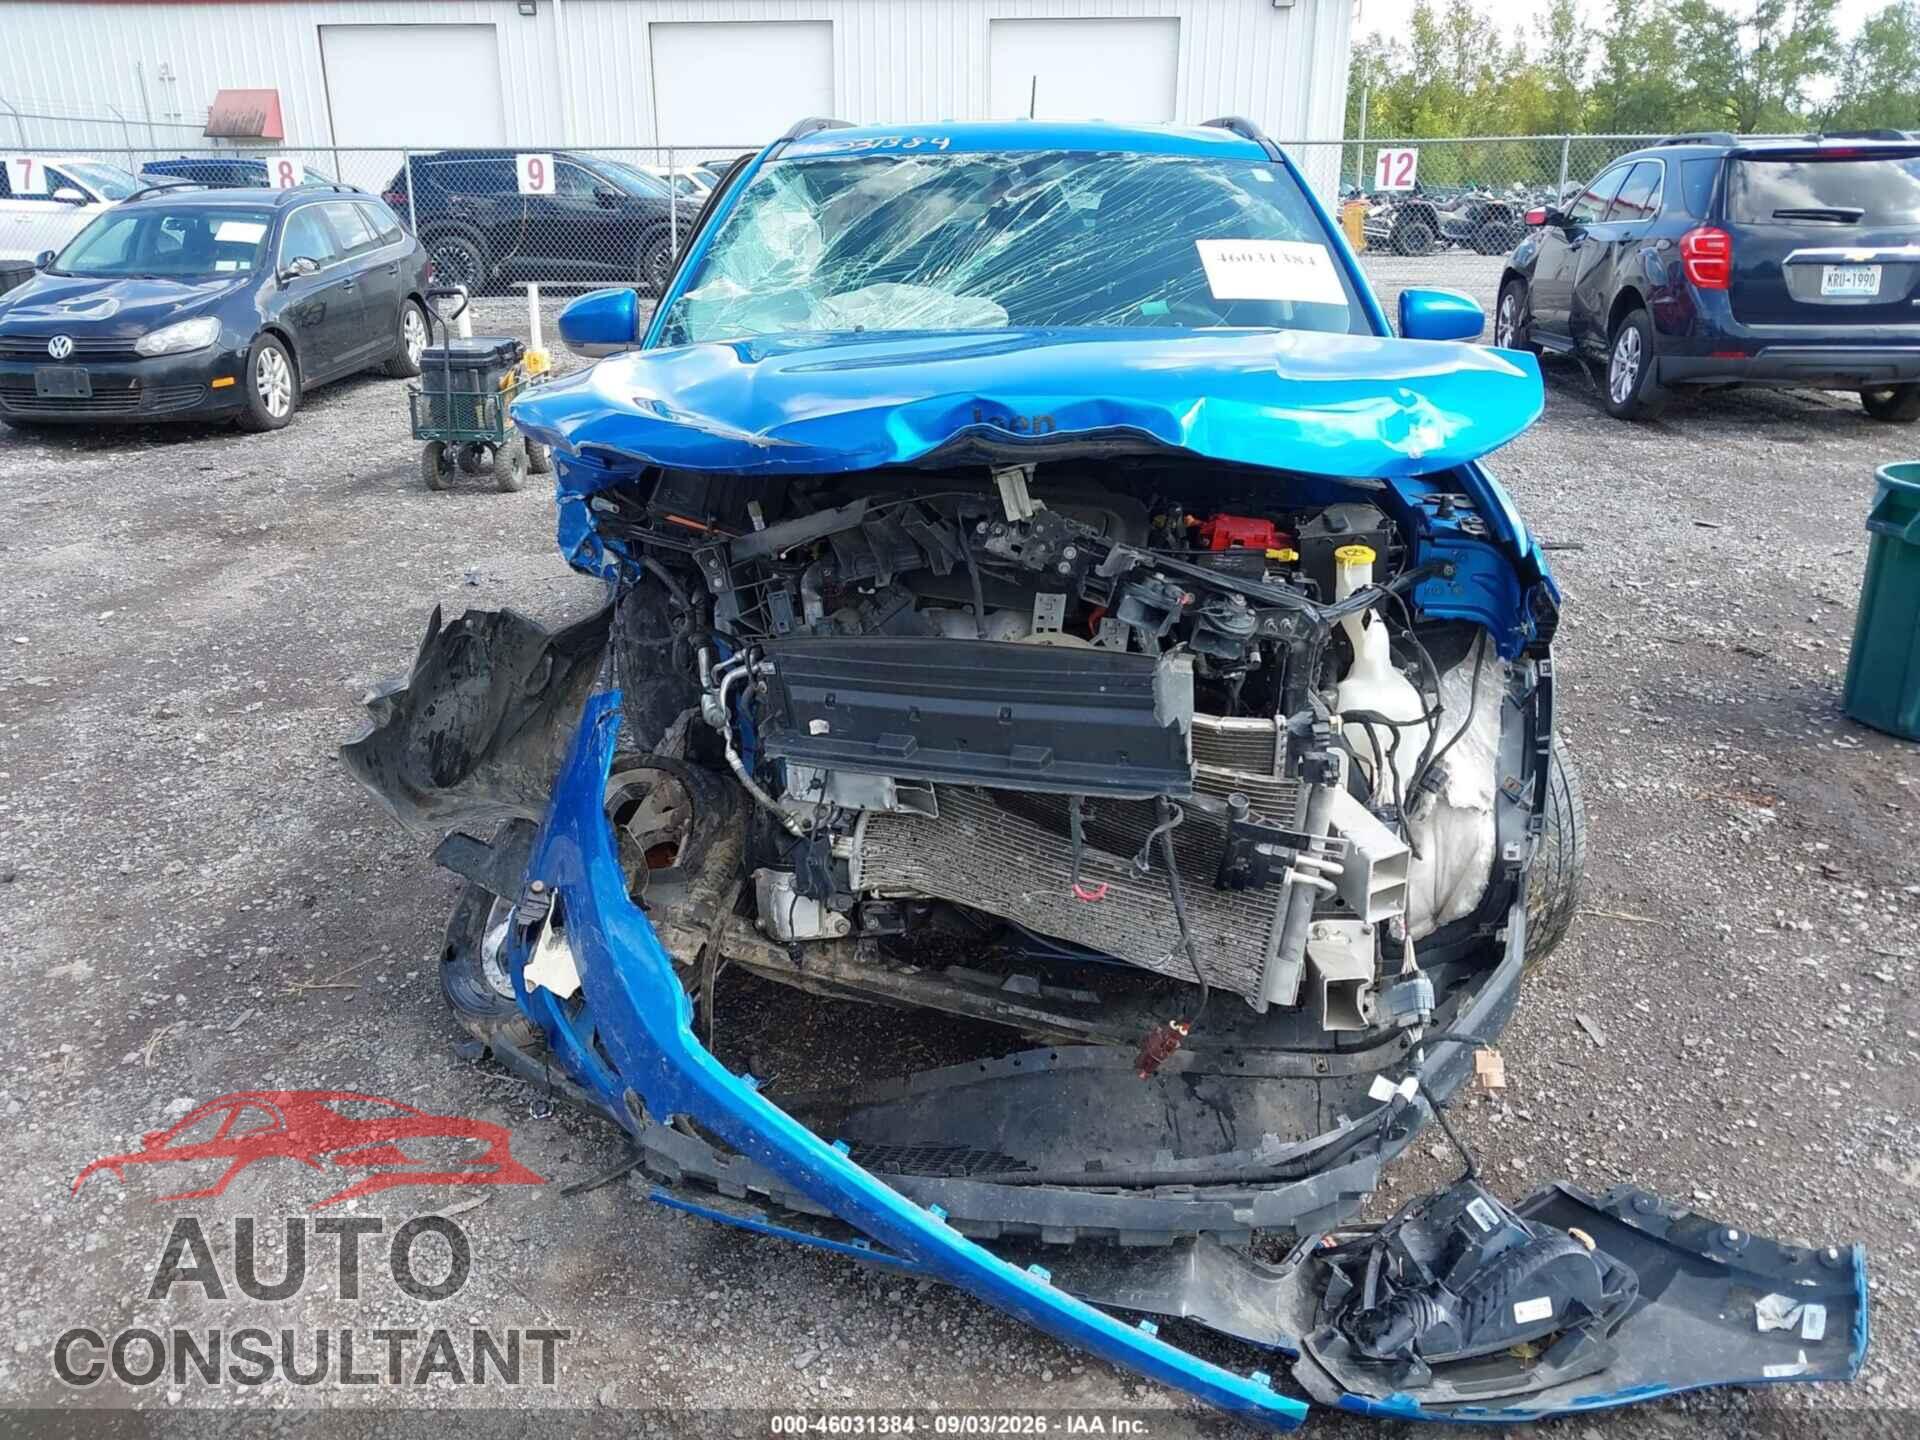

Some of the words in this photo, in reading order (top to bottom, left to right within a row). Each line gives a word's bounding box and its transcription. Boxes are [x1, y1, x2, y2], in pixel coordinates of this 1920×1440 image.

[16, 159, 32, 190] 7
[278, 161, 295, 188] 8
[528, 158, 544, 190] 9
[1380, 152, 1414, 186] 12
